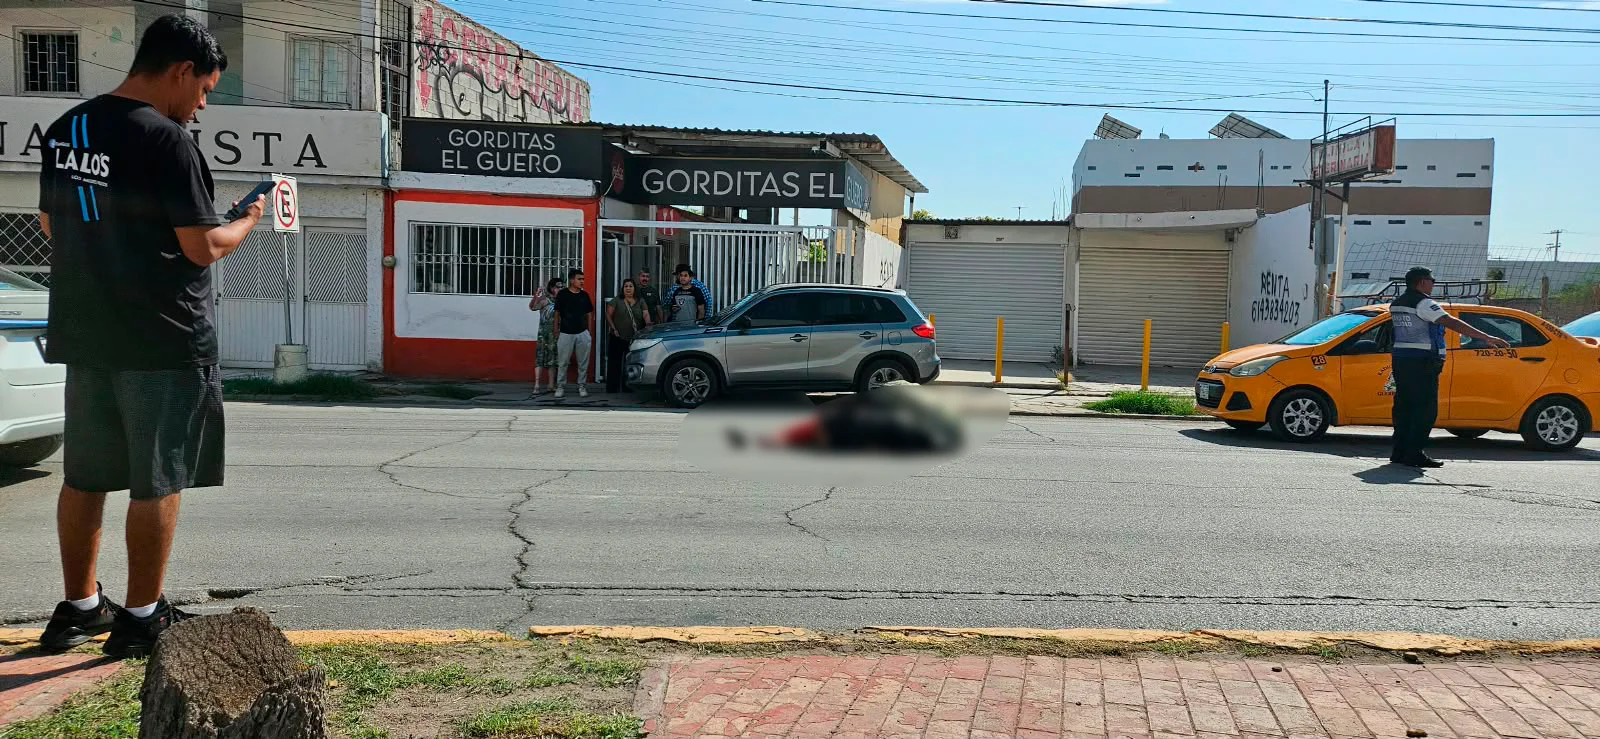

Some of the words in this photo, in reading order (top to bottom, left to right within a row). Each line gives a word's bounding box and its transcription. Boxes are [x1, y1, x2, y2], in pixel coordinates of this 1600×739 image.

[448, 129, 555, 151] GORDITAS
[442, 149, 468, 169] EL
[476, 151, 562, 174] GUERO
[642, 168, 800, 198] GORDITAS
[809, 172, 845, 199] EL
[1260, 271, 1290, 299] RENTA
[1312, 355, 1326, 365] 28
